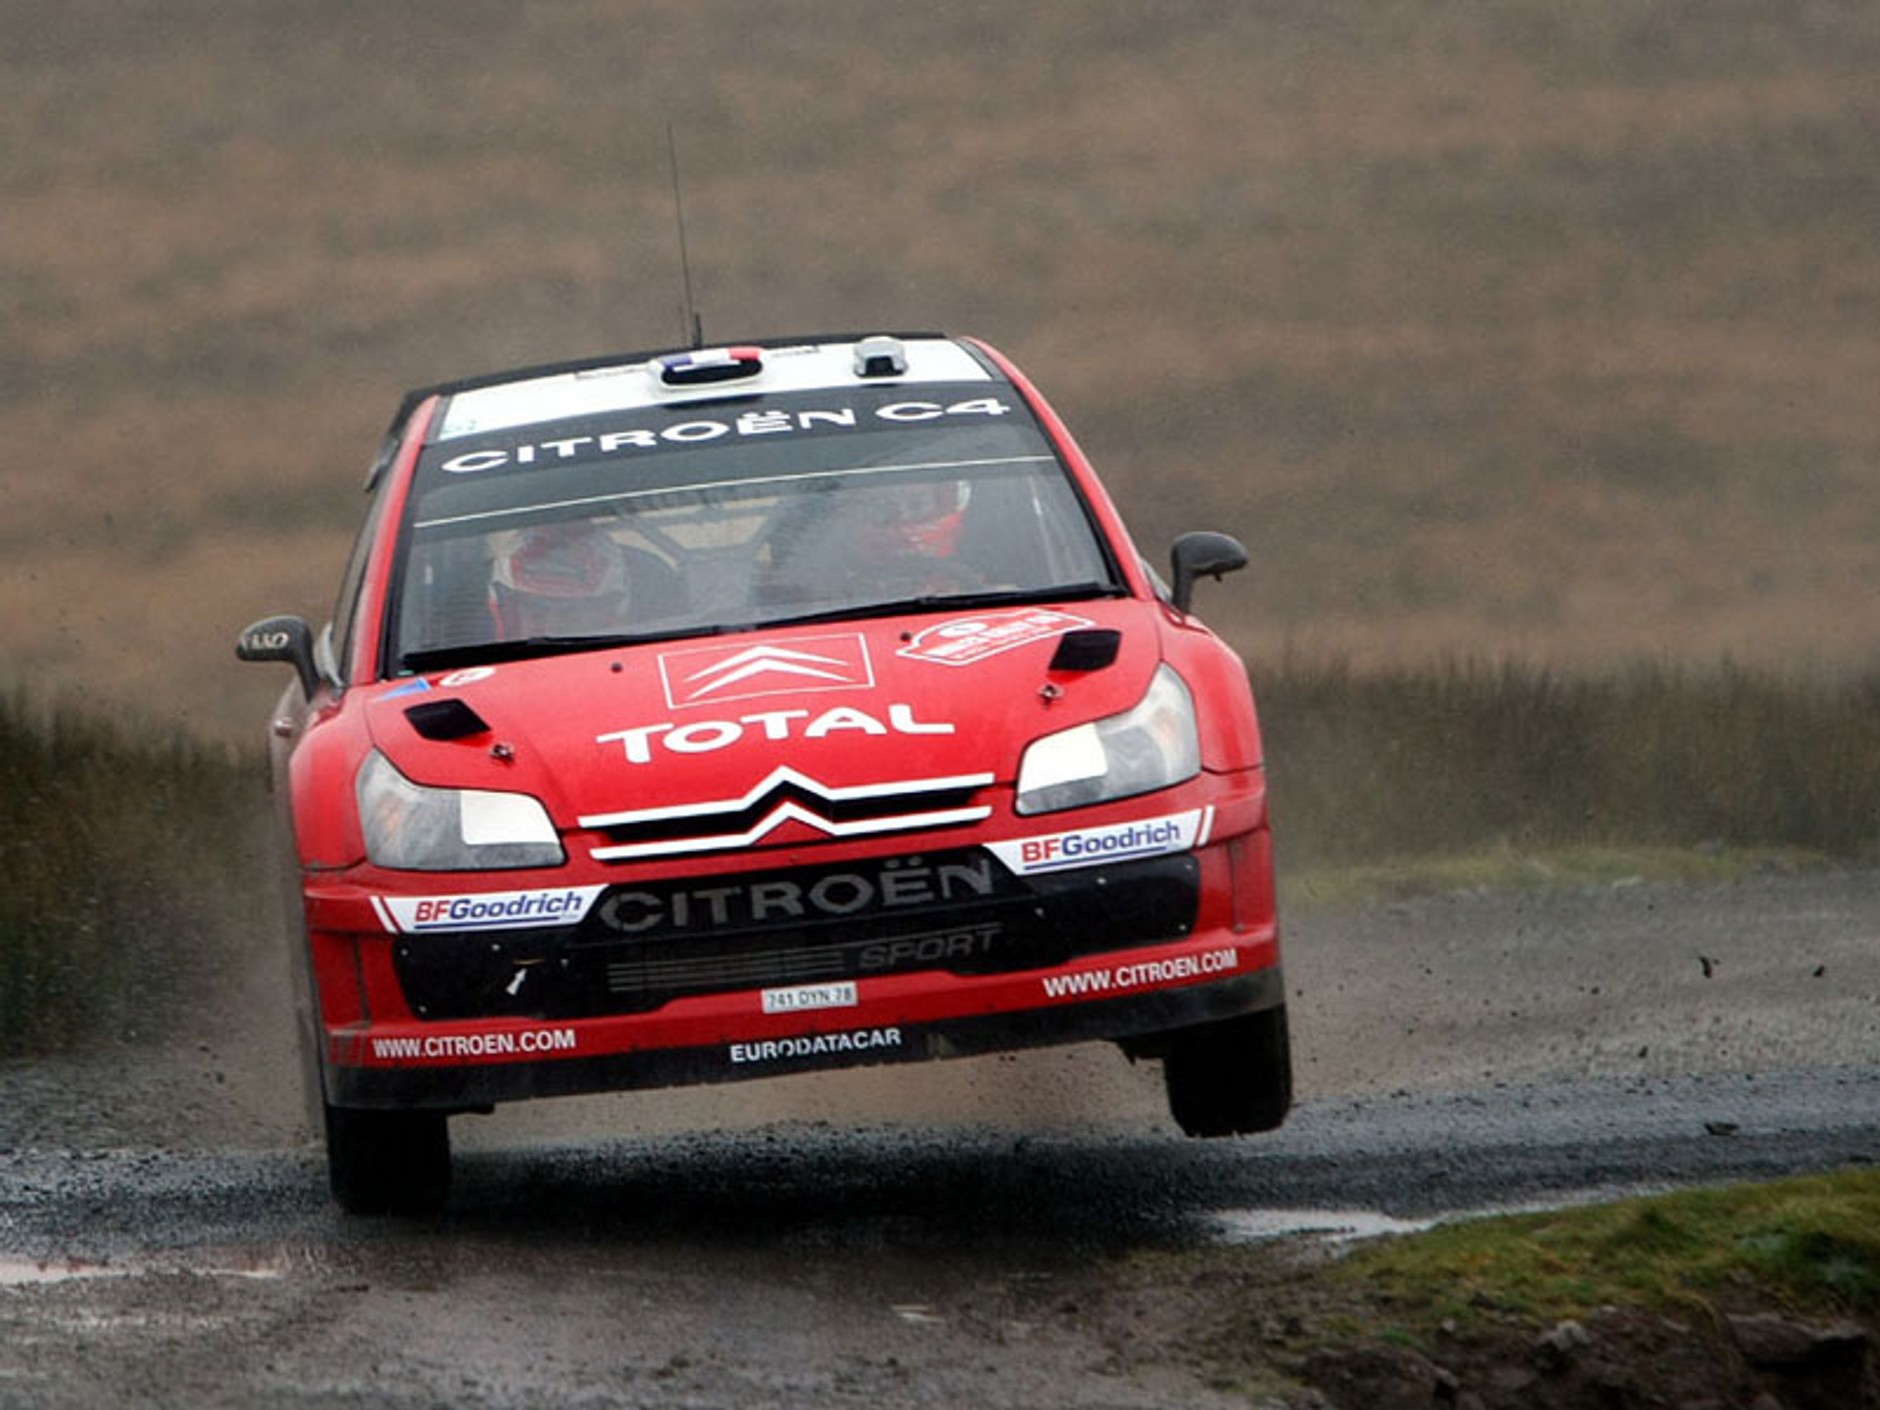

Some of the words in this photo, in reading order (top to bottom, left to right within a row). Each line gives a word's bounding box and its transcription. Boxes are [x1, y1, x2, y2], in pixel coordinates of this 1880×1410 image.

[442, 408, 857, 475] CITROËN
[875, 396, 1011, 422] C4
[596, 704, 956, 764] TOTAL
[1020, 820, 1182, 864] BFGoodrich
[414, 891, 583, 923] BFGoodrich
[597, 856, 996, 933] CITROËN
[858, 929, 1003, 970] SPORT
[1042, 948, 1238, 999] WWW.CITROEN.COM
[372, 1029, 577, 1059] WWW.CITROEN.COM
[729, 1027, 902, 1063] EURODATACAR
